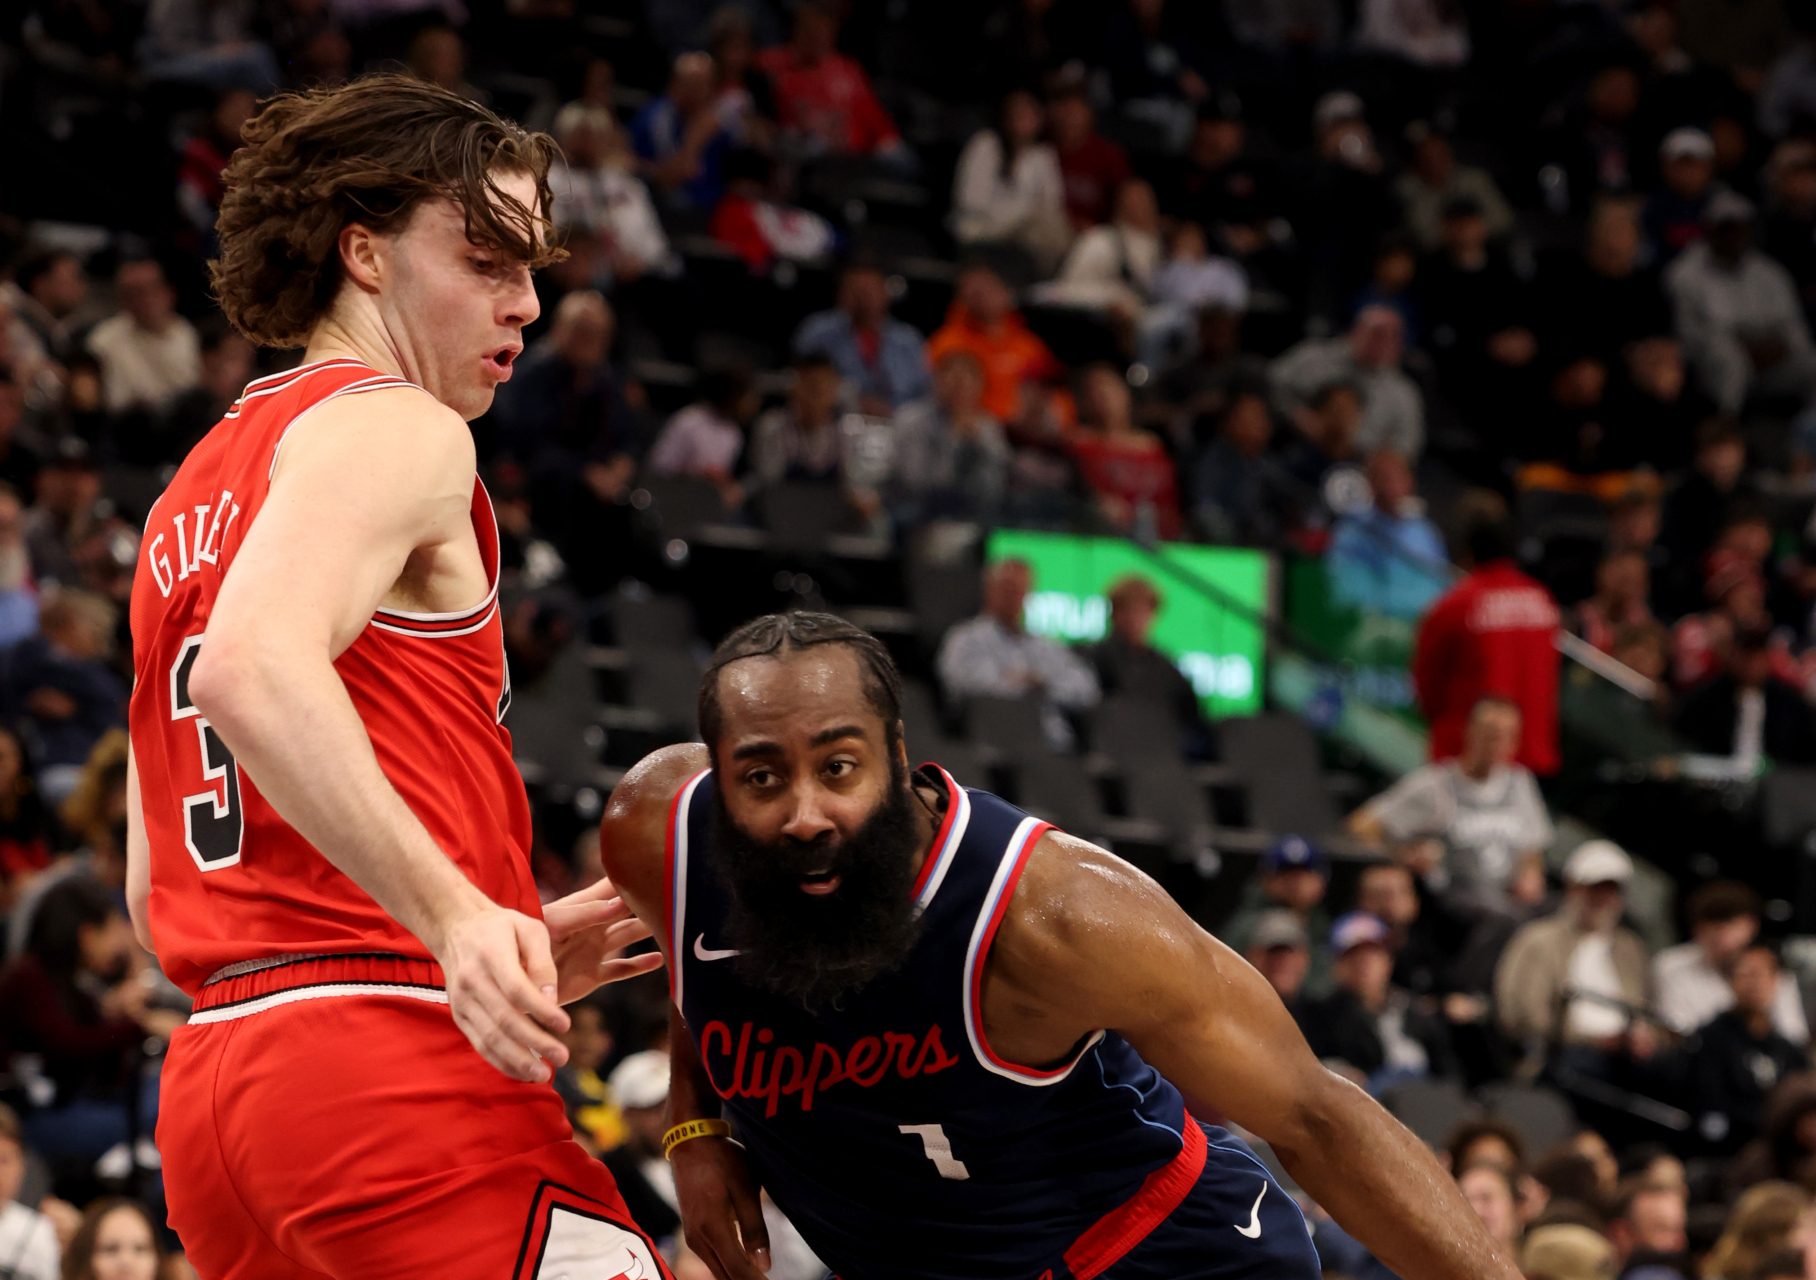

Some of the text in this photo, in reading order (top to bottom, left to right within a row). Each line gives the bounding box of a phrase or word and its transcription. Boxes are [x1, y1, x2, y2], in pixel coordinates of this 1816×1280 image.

[170, 633, 244, 872] 3
[701, 1020, 959, 1119] Clippers
[898, 1124, 970, 1181] 1
